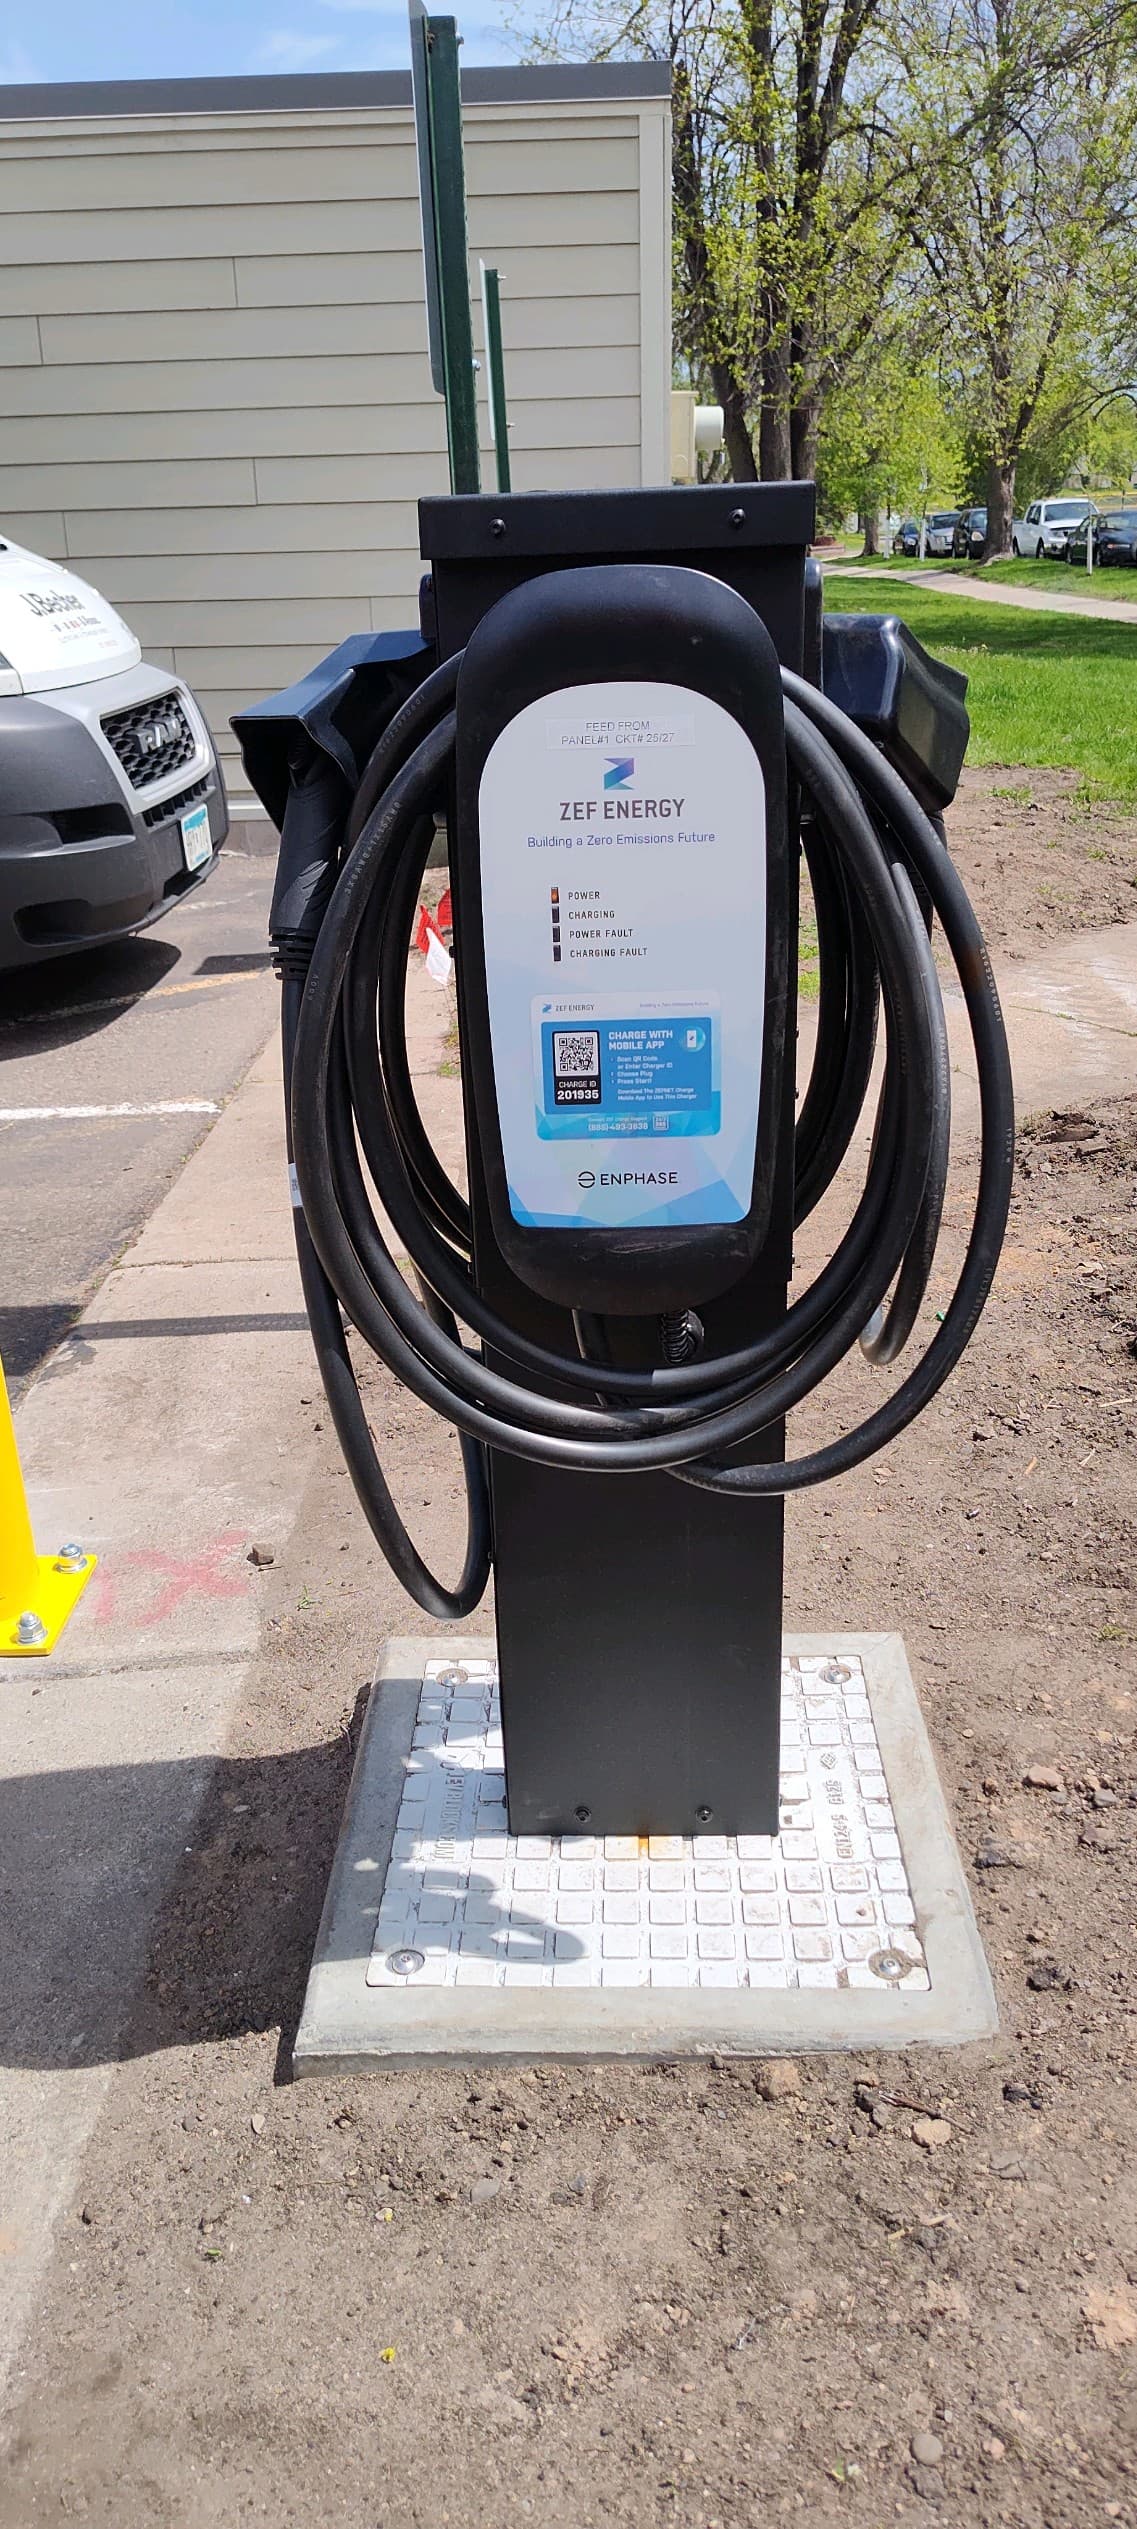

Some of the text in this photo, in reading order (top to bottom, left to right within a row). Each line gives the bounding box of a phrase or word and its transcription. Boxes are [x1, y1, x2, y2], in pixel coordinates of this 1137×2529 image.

[585, 720, 650, 732] FEED FROM
[137, 717, 181, 754] RAM
[561, 734, 609, 745] PANEL#1
[615, 733, 644, 744] CKT#
[559, 798, 685, 821] ZEF ENERGY
[527, 832, 715, 848] Building a Zero Emissions Future
[568, 891, 600, 900] POWER
[568, 910, 615, 919] CHARGING
[569, 928, 633, 939] POWER FAULT
[570, 947, 647, 958] CHARGING FAULT
[556, 1004, 567, 1012] ZEF
[608, 1030, 673, 1040] CHARGE WITH
[608, 1040, 665, 1050] MOBILE APP
[559, 1080, 597, 1089] CHARGE ID
[557, 1089, 599, 1100] 201935
[600, 1172, 678, 1186] ENPHASE
